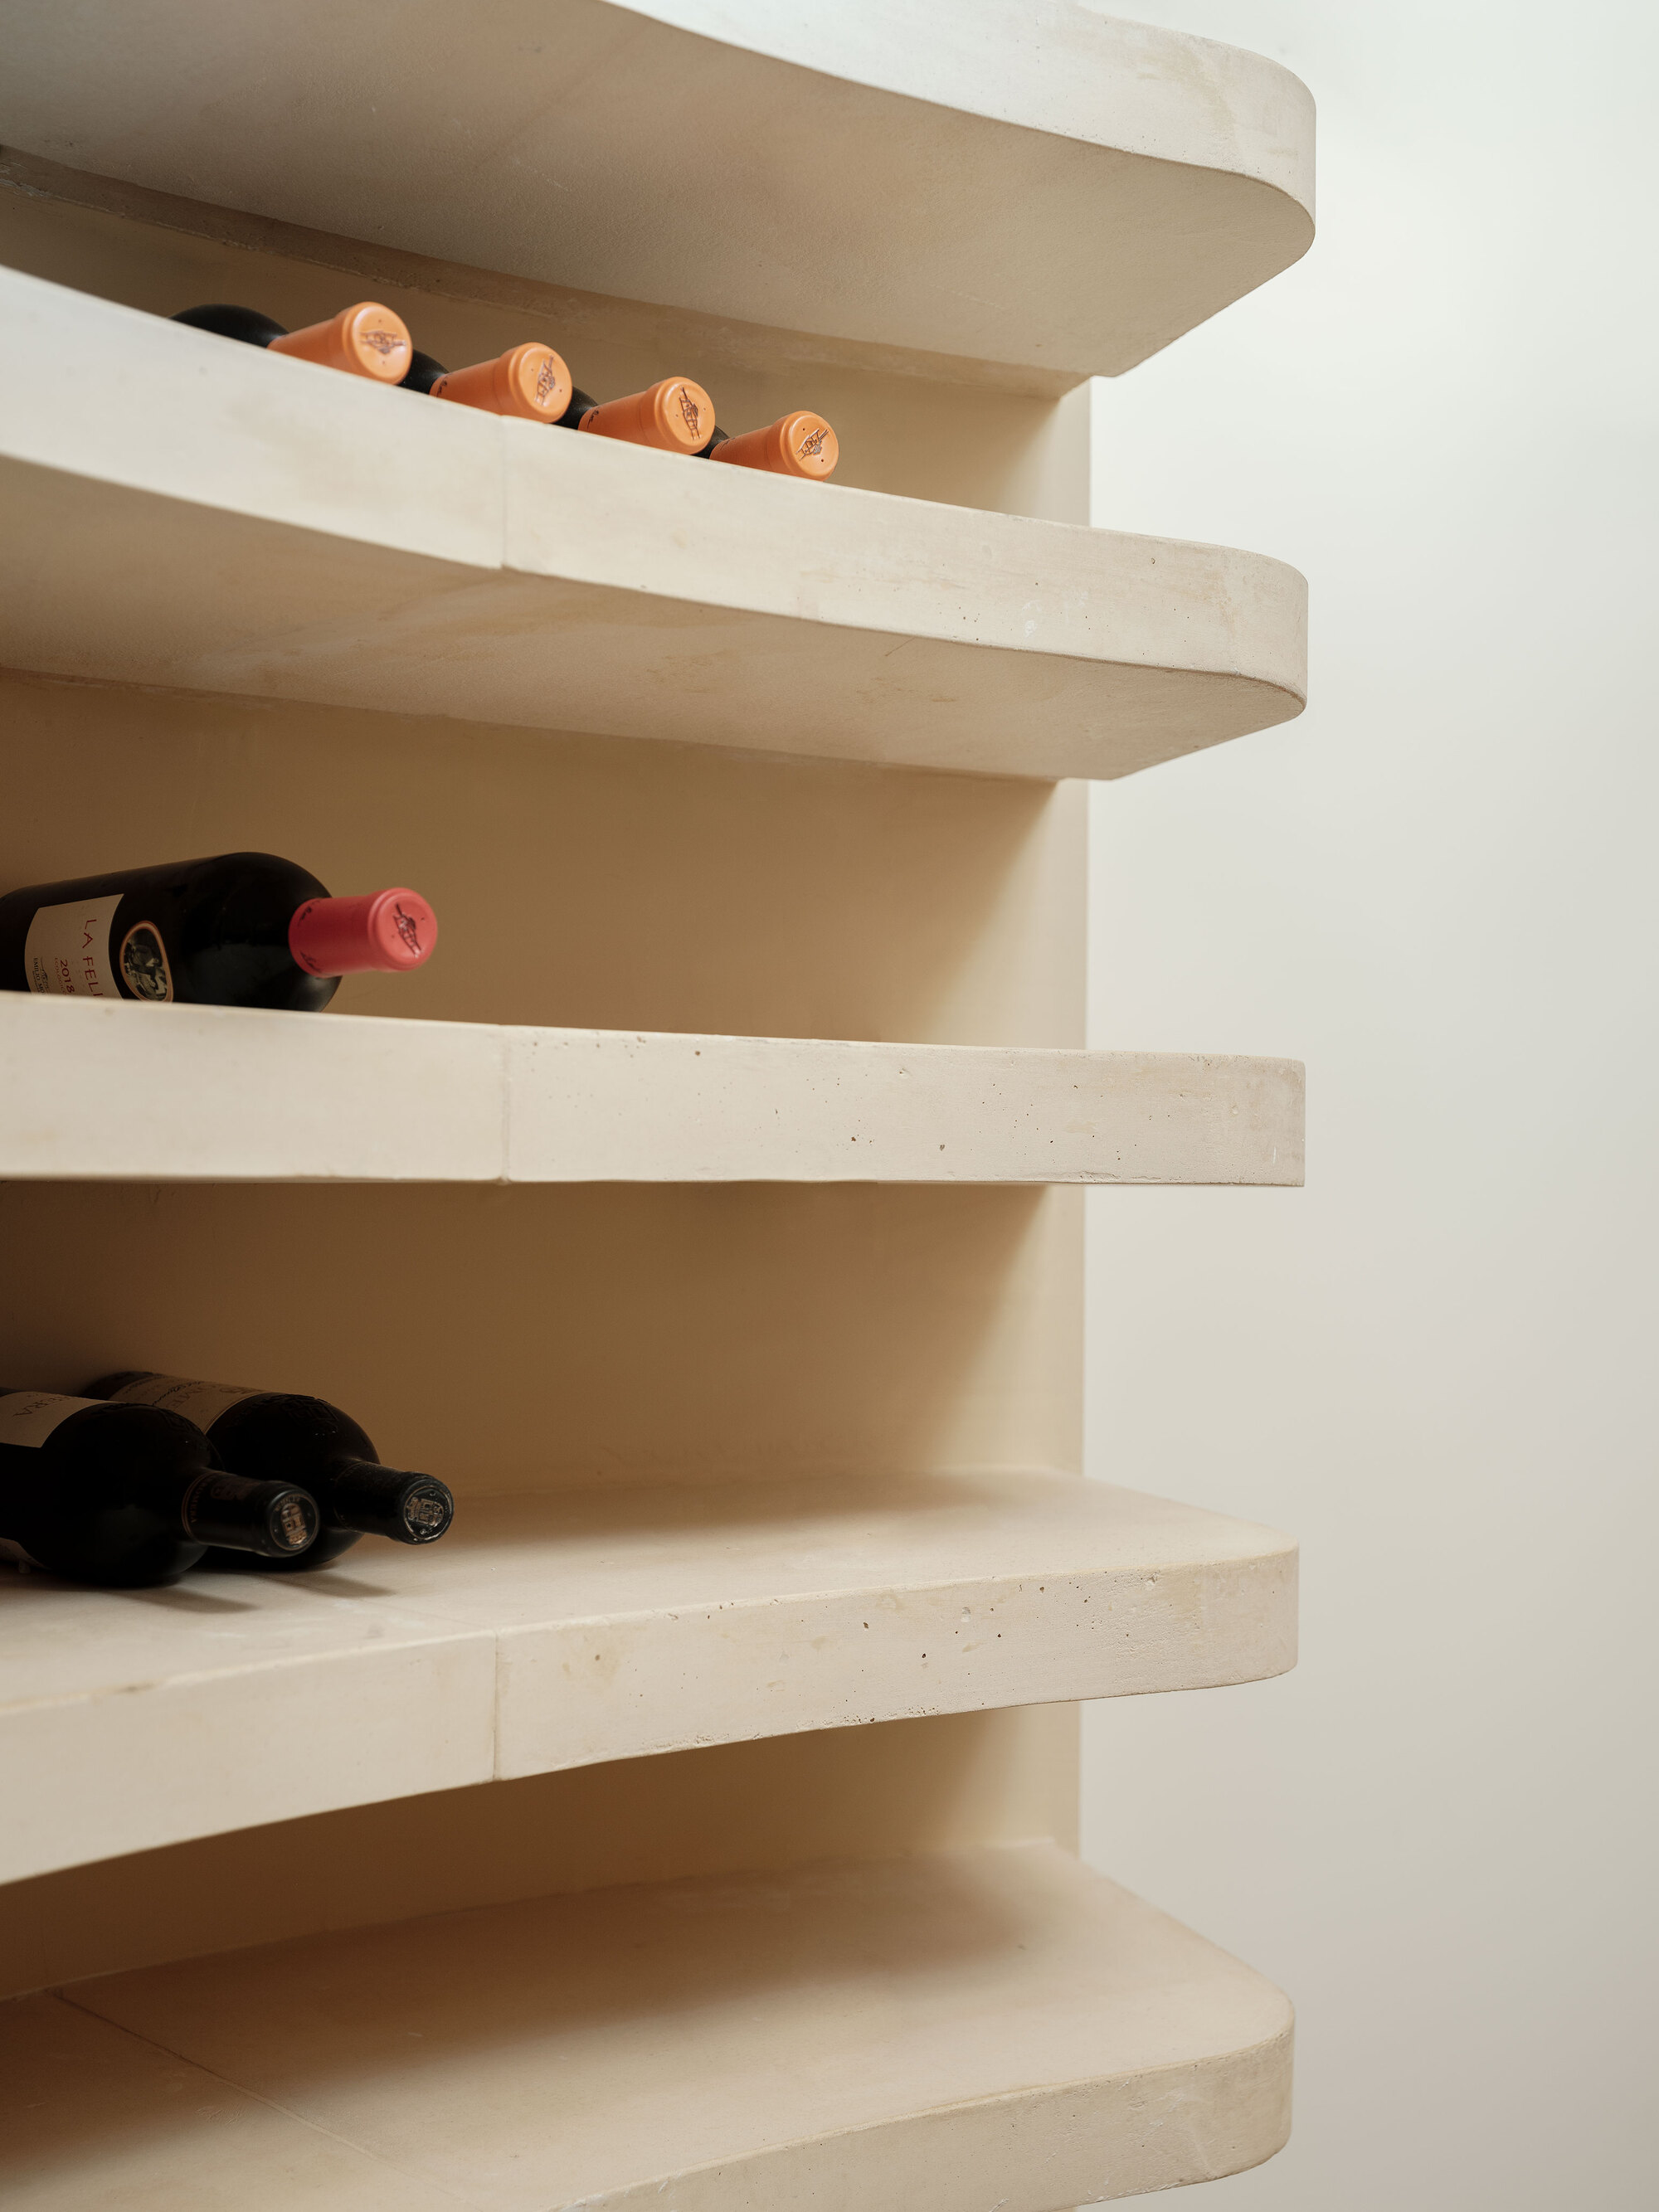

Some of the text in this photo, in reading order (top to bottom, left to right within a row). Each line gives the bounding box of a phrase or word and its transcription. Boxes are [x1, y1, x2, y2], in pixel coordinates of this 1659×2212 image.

[60, 960, 75, 993] 2018
[81, 918, 104, 996] LA FELI
